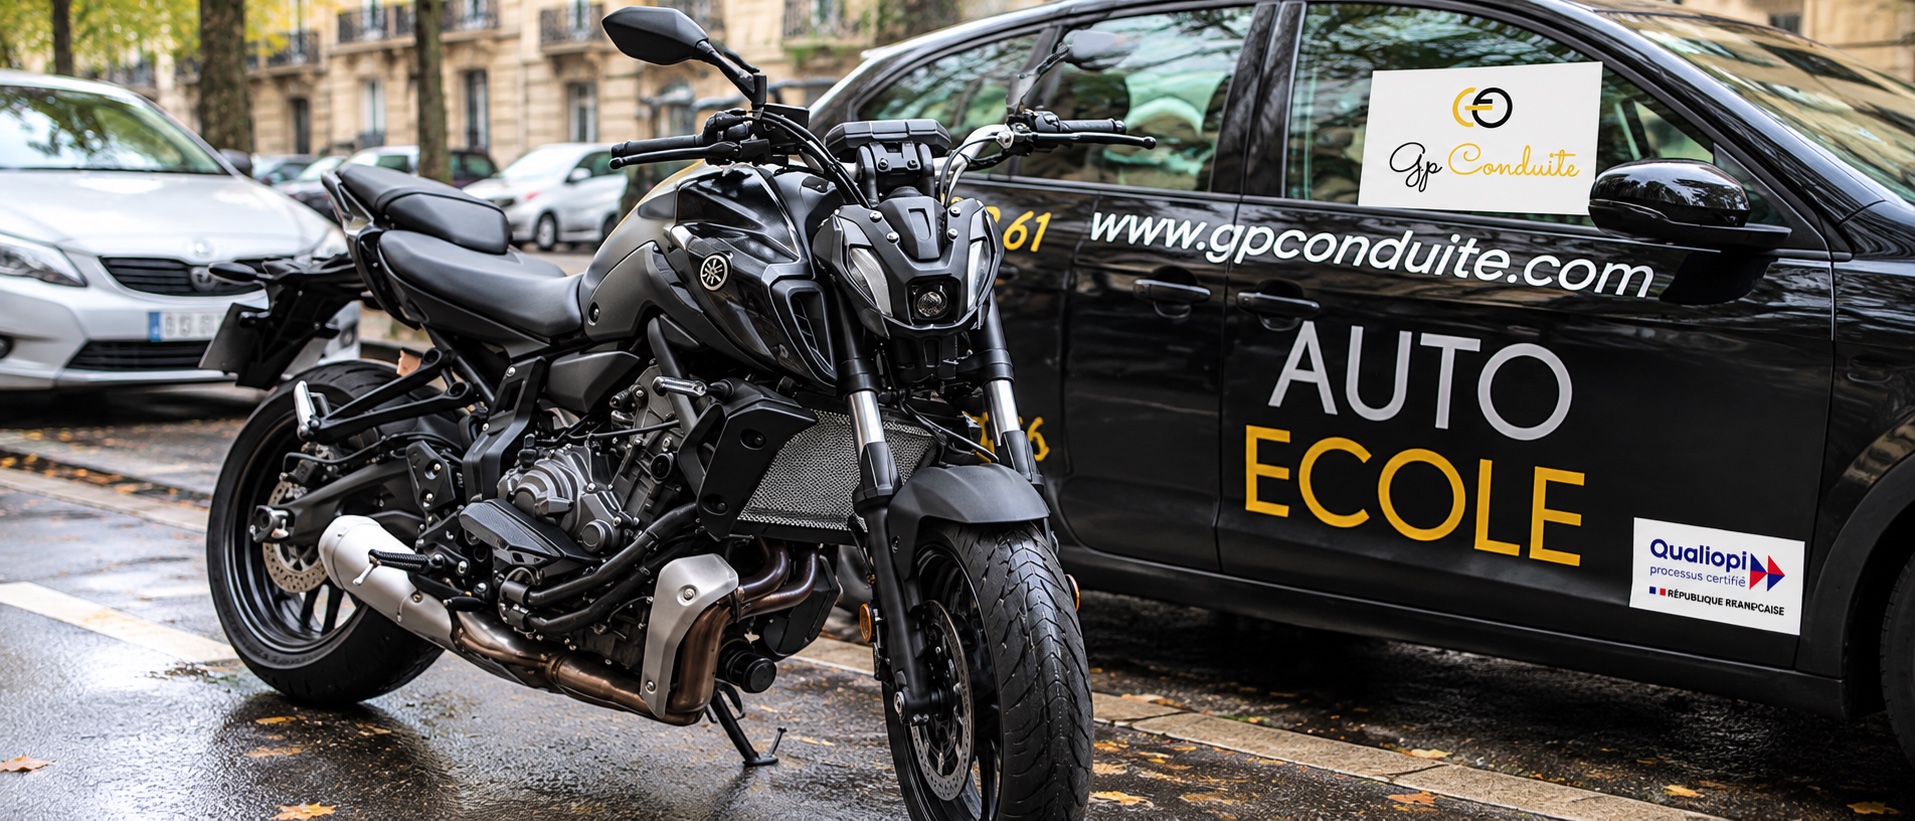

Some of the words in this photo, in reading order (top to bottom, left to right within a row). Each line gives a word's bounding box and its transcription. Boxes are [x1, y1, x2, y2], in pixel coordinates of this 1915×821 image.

[1389, 142, 1443, 192] Gp
[1448, 143, 1580, 178] Conduite
[1003, 210, 1052, 252] 61
[1090, 212, 1655, 298] www.gpconduite.com
[1268, 320, 1573, 441] AUTO
[1245, 424, 1585, 567] ECOLE
[1650, 538, 1747, 572] Qualiopi
[1650, 565, 1703, 581] processus
[1667, 588, 1723, 606] RÉPUBLIQUE
